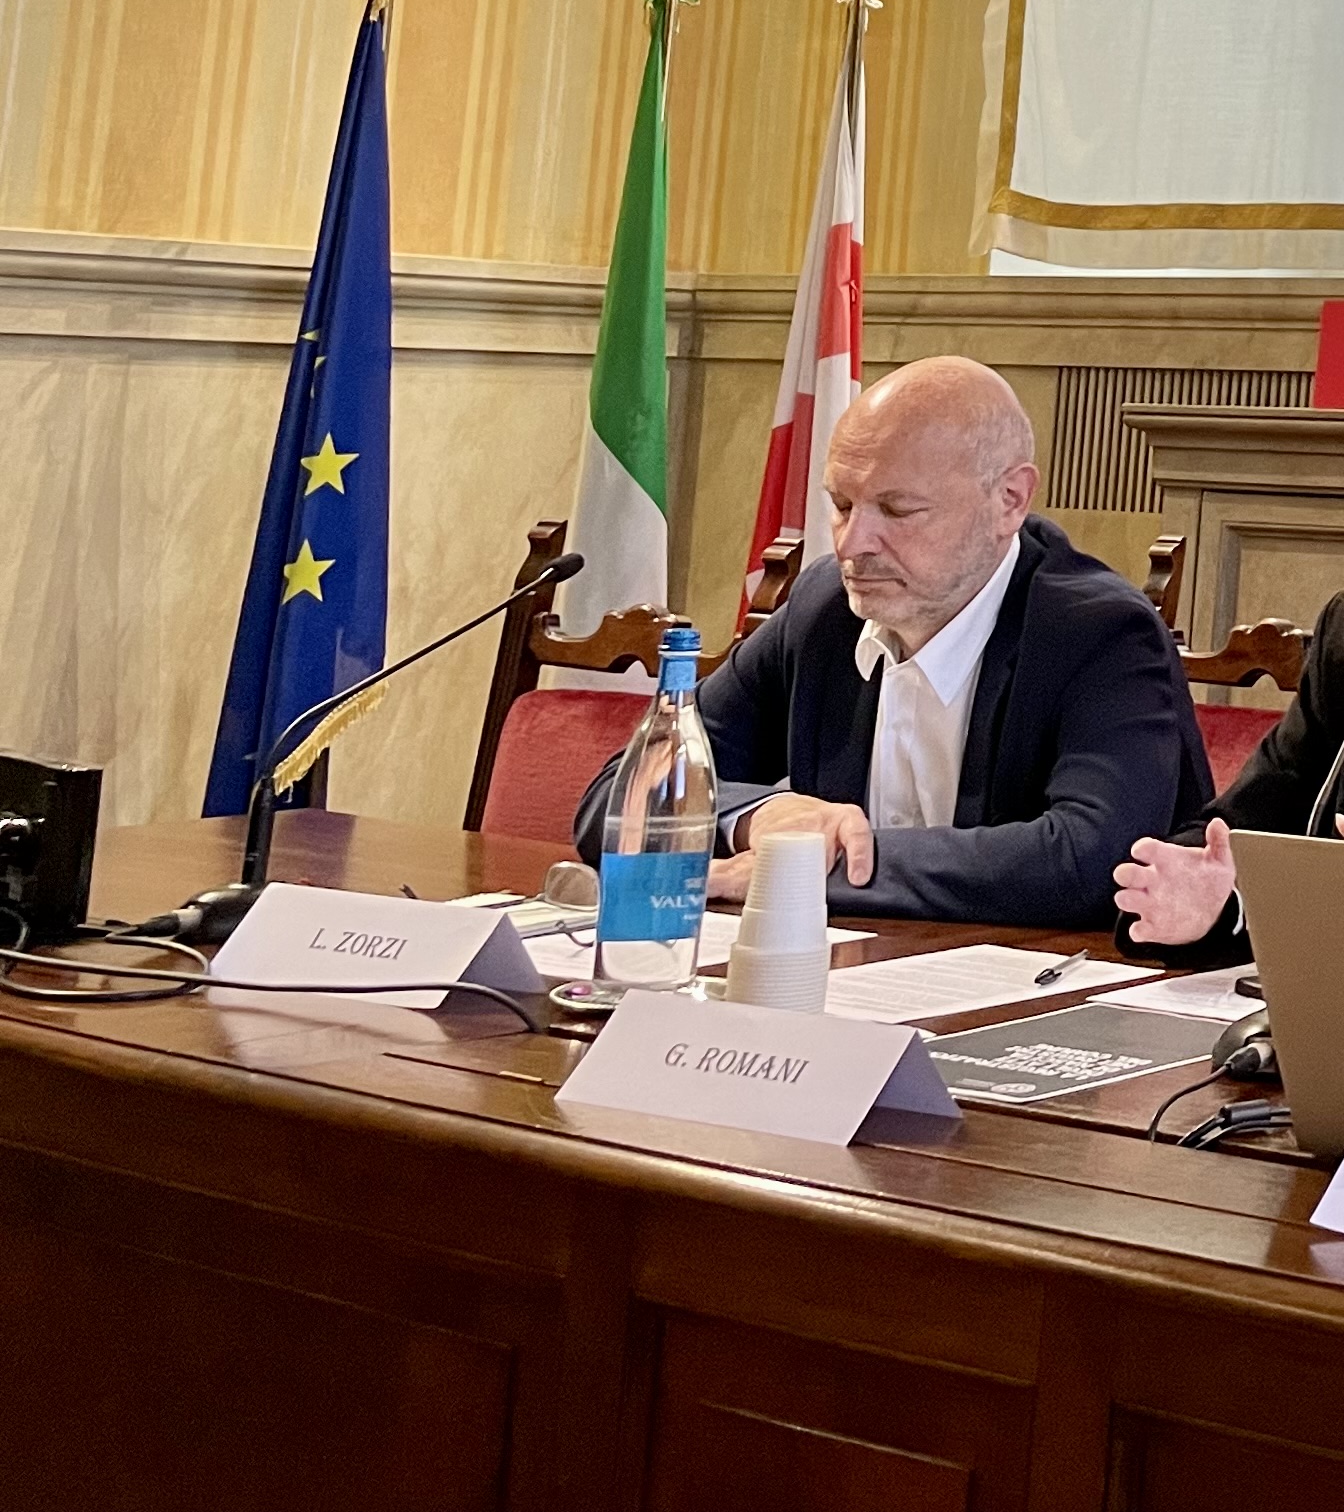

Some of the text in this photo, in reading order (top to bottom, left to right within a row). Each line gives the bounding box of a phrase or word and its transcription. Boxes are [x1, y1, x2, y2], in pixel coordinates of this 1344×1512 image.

[308, 927, 408, 960] L. ZORZI
[664, 1043, 810, 1084] G. ROMANI
